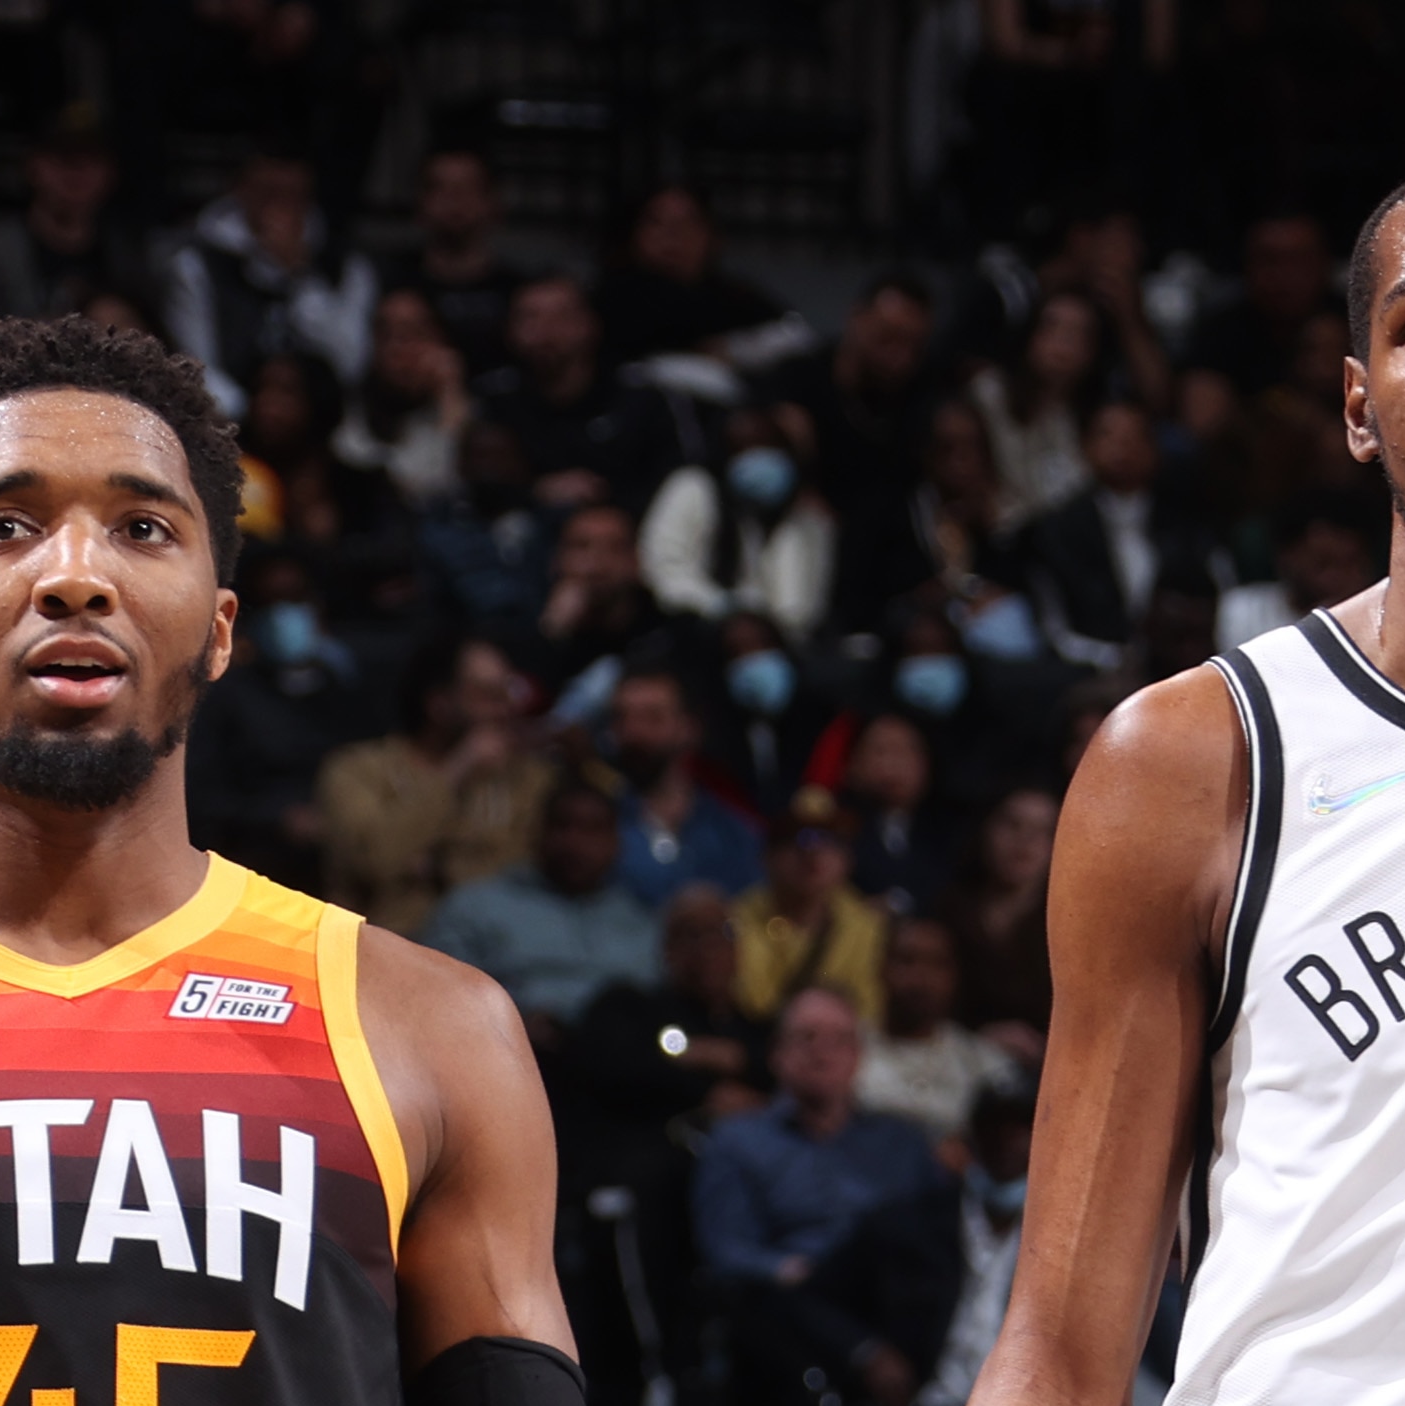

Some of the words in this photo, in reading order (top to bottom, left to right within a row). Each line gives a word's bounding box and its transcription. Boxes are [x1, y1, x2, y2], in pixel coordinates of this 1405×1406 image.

[181, 981, 214, 1013] 5
[227, 982, 253, 994] FOR
[257, 986, 279, 997] THE
[217, 1001, 284, 1018] FIGHT
